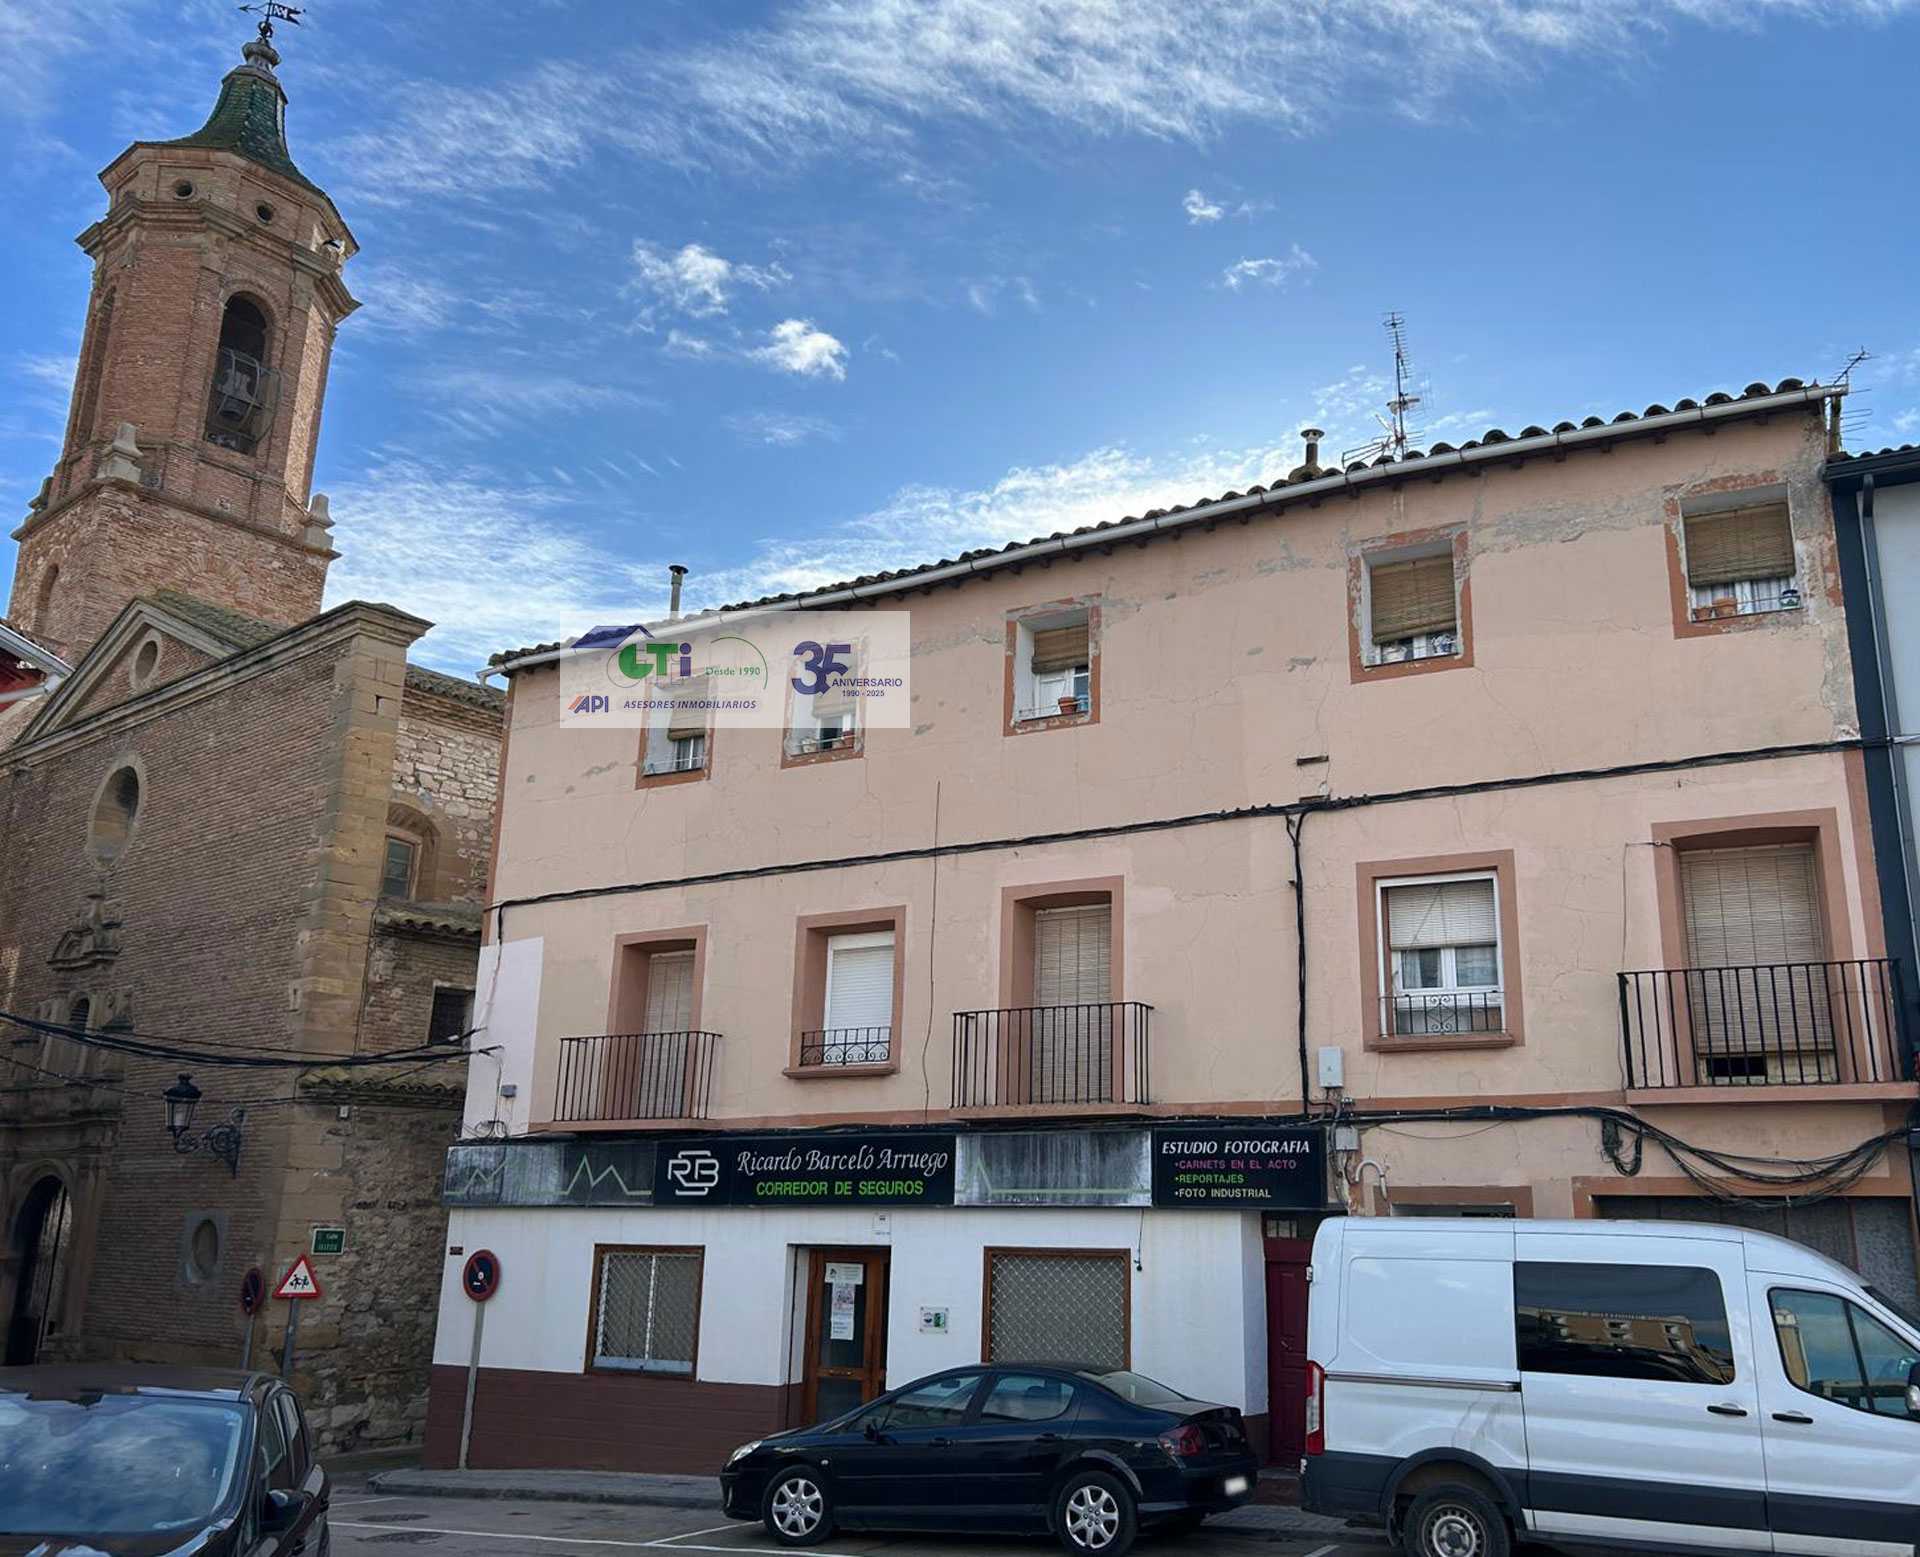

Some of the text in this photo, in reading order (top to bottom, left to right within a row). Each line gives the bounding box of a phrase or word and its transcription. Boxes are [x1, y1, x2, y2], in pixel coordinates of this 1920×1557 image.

[1162, 1140, 1310, 1154] ESTUDIO FOTOGRAFIA
[737, 1145, 948, 1177] Ricardo Barceló Arruego
[1231, 1160, 1244, 1169] EN
[1250, 1160, 1262, 1169] EL
[1268, 1159, 1297, 1169] ACTO
[756, 1180, 924, 1195] CORREDOR DE SEGUROS
[1211, 1188, 1271, 1198] INDUSTRIAL
